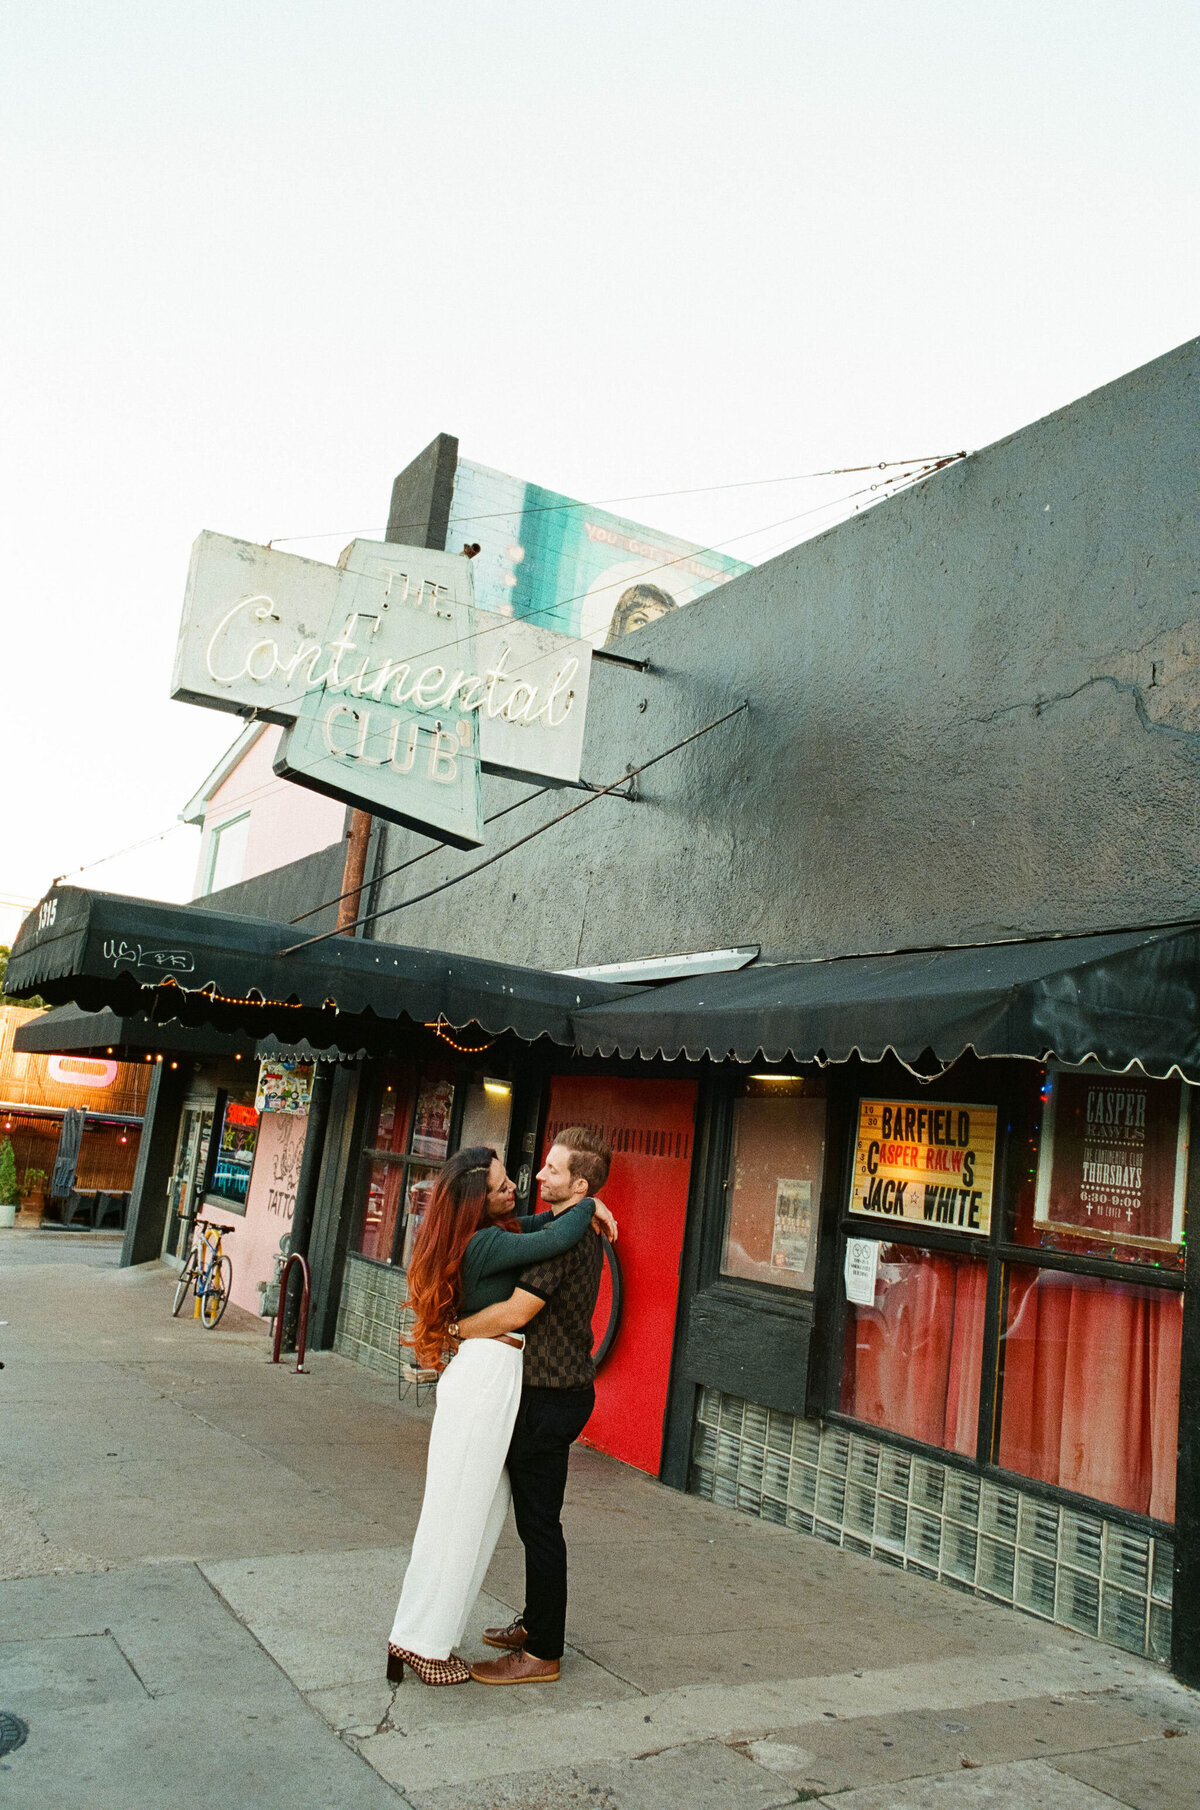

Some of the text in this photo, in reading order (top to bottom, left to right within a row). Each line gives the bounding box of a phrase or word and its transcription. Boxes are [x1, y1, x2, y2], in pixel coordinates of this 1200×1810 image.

[380, 566, 453, 620] THE
[206, 594, 579, 728] Continental
[322, 702, 462, 784] CLUB
[864, 1106, 873, 1114] 10
[868, 1118, 878, 1126] 30
[881, 1106, 970, 1148] BARFIELD
[1086, 1091, 1146, 1127] CASPER
[1086, 1123, 1146, 1141] RAWLS
[867, 1141, 976, 1187] CASPER RALWS
[1082, 1161, 1142, 1189] THURSDAYS
[267, 1188, 296, 1220] TATTO
[862, 1177, 982, 1229] JACK WHITE
[1080, 1191, 1142, 1209] 6:30-9:00
